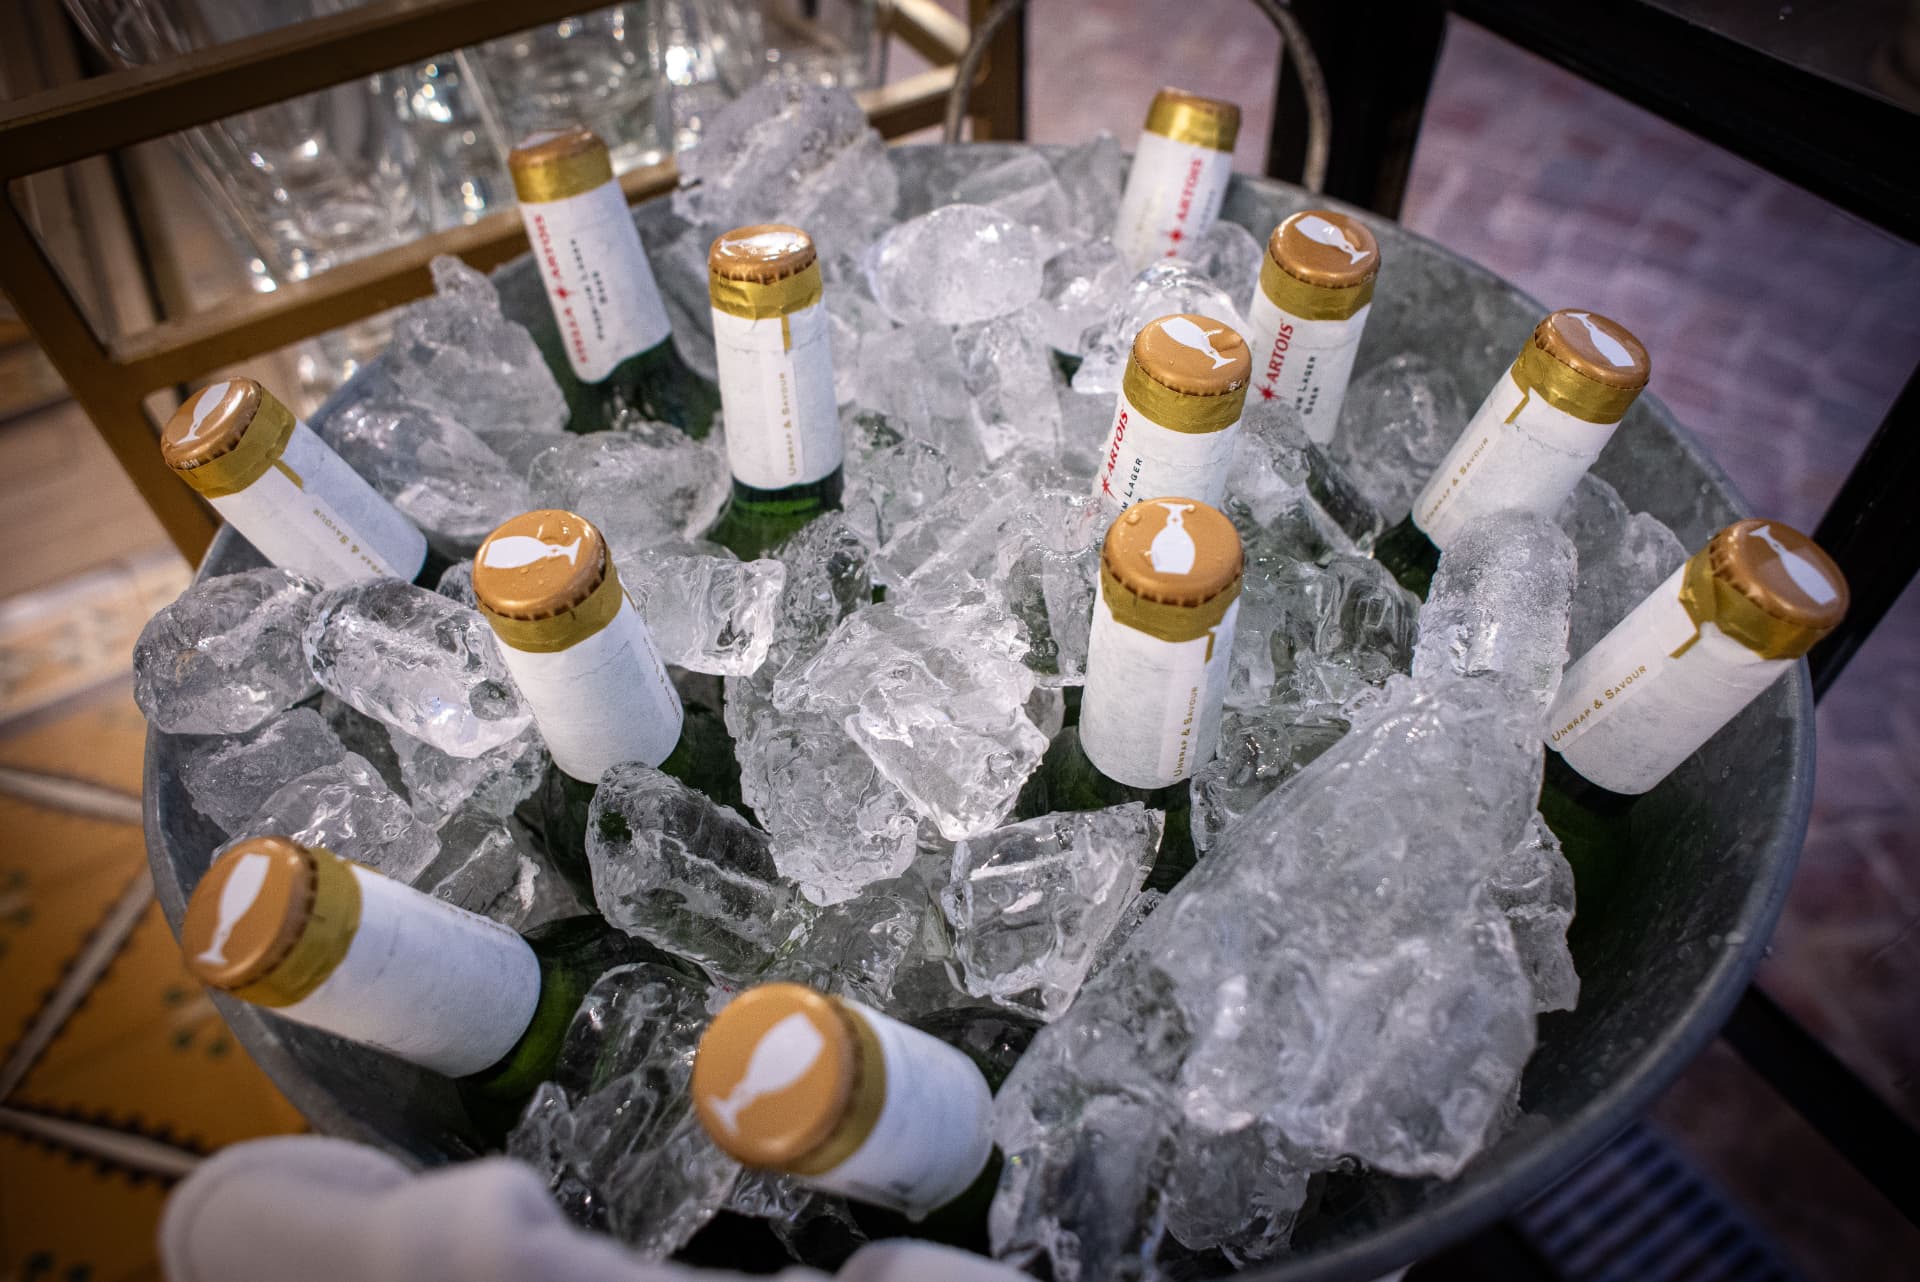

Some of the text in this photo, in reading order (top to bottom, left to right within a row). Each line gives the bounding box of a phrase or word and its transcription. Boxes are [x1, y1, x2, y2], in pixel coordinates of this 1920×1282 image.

[1268, 322, 1294, 383] ARTOIS
[1299, 356, 1316, 391] LAGER
[1105, 410, 1129, 476] ARTOIS
[1125, 458, 1143, 497] LAGER
[1593, 698, 1605, 710] &
[1604, 666, 1646, 700] SAVOUR
